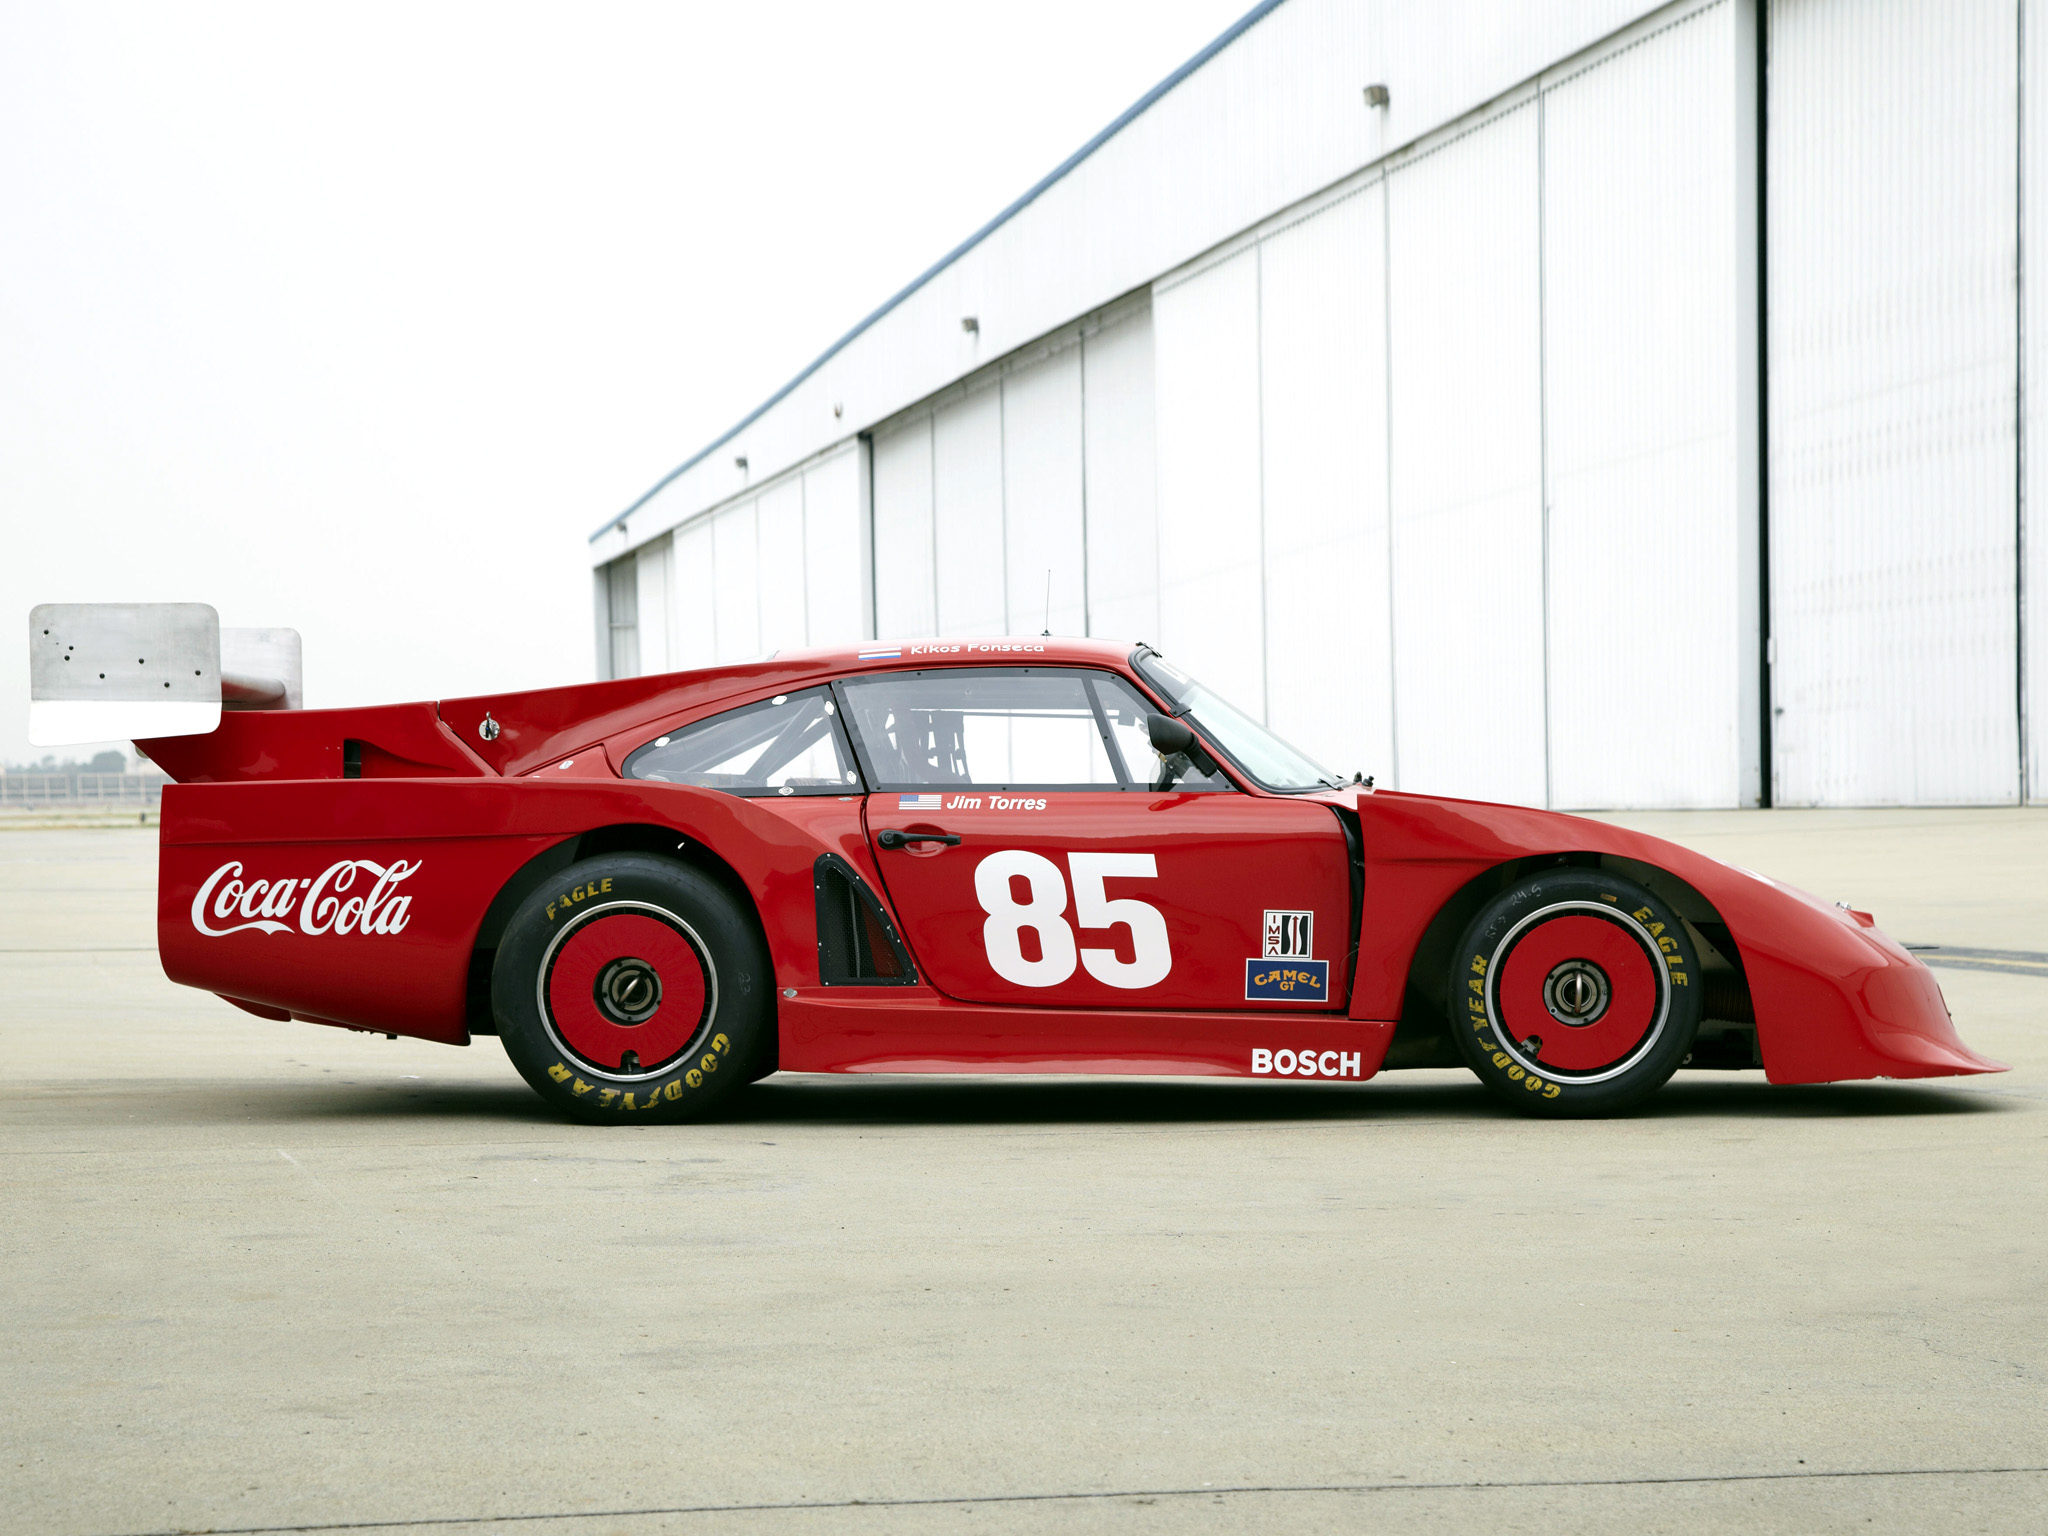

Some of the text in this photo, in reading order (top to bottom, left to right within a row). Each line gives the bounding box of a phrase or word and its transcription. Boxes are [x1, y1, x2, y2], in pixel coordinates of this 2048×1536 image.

[910, 643, 1045, 655] Kikos Fonseca
[946, 795, 1048, 811] Jim Torres
[191, 859, 423, 937] Coca-Cola
[974, 849, 1173, 990] 85
[1267, 914, 1281, 956] IMSA
[1632, 905, 1689, 987] EAGLE
[1254, 969, 1321, 988] CAMEL
[1279, 981, 1296, 992] GT
[1251, 1048, 1361, 1077] BOSCH
